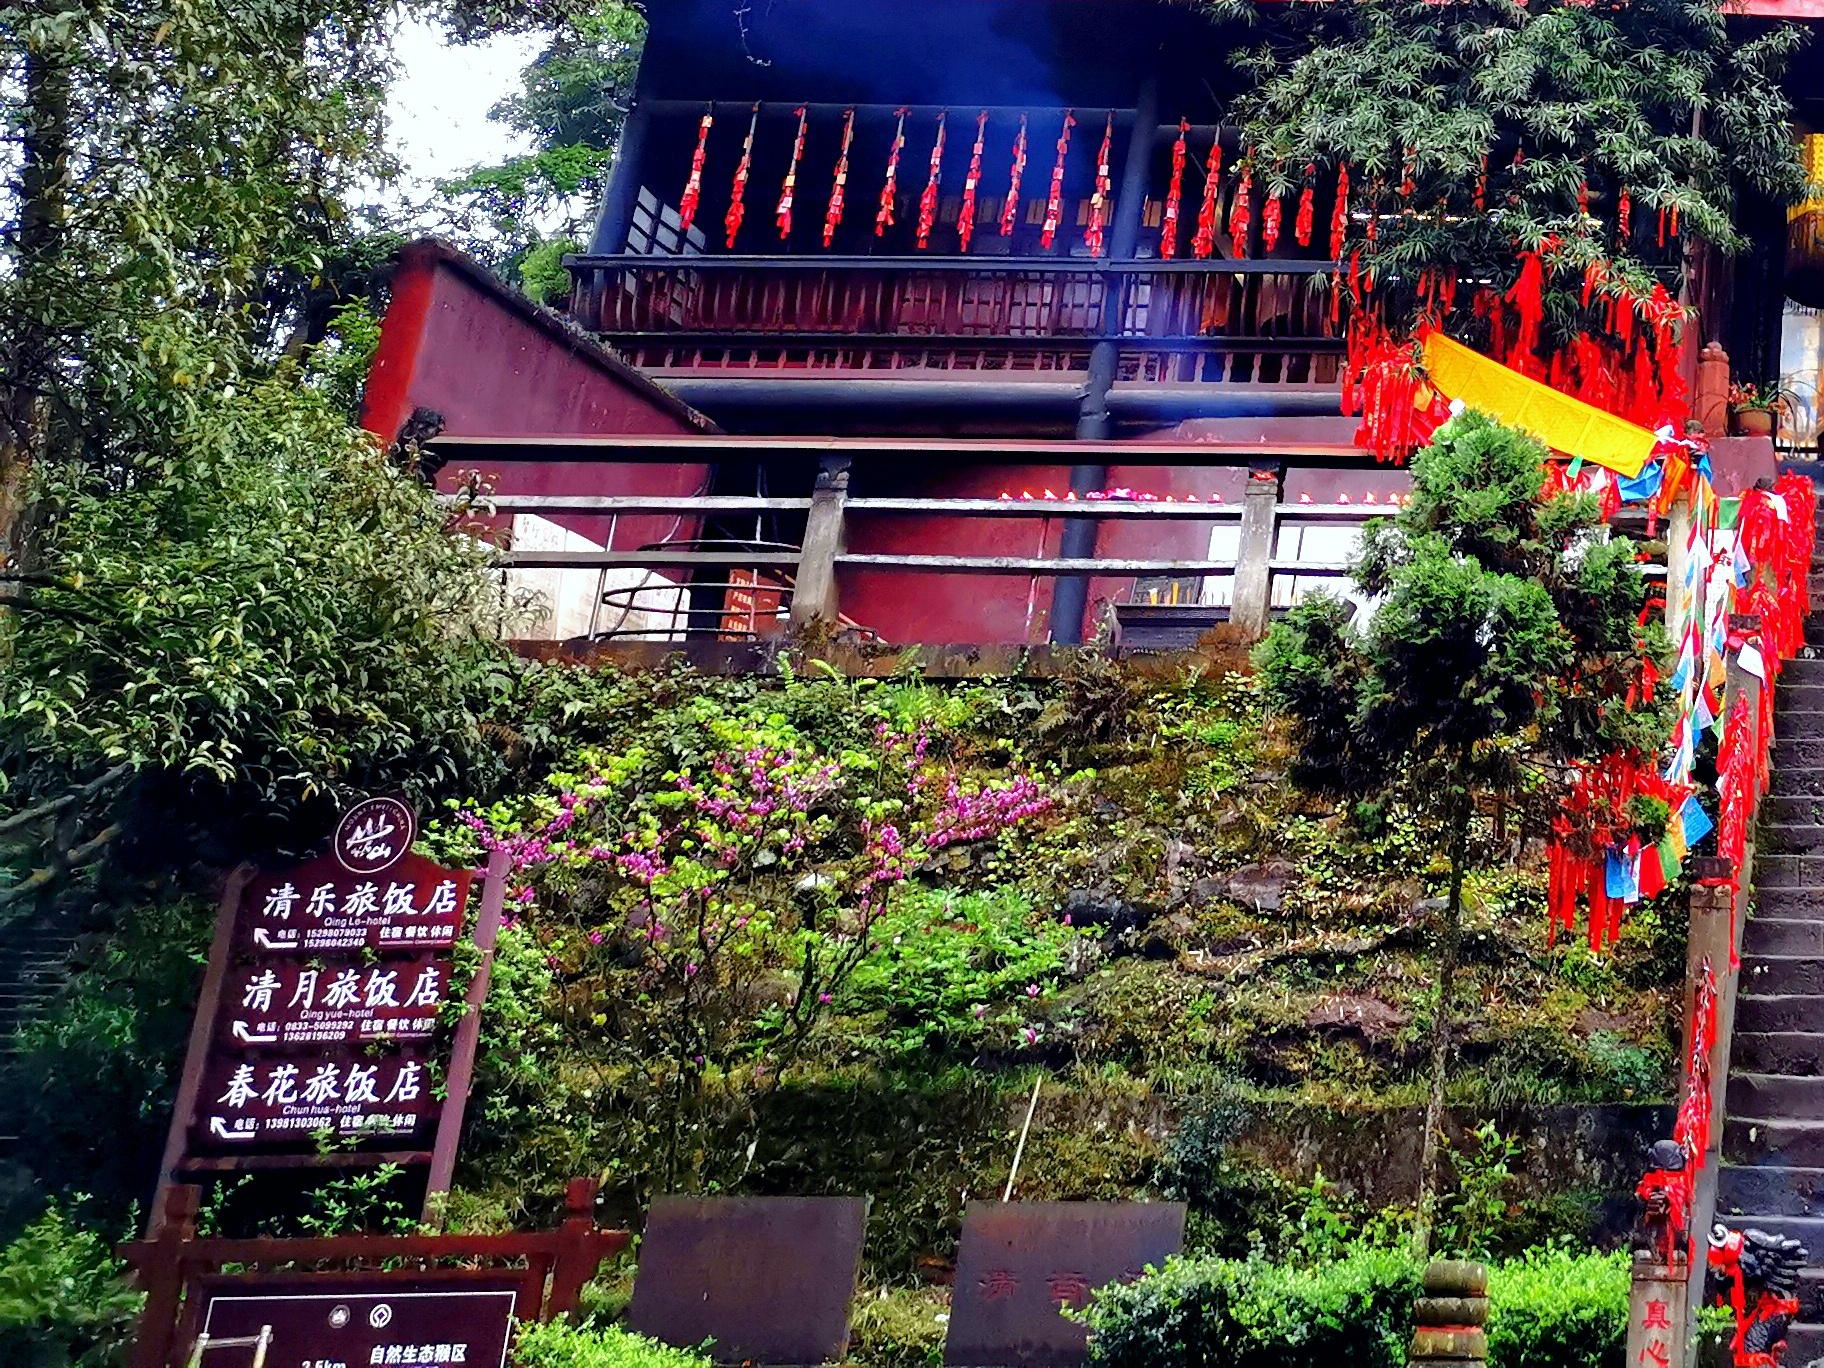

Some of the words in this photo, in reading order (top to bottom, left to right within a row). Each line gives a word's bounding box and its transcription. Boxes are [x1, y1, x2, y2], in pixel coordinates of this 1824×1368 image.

[263, 880, 457, 920] 清乐旅饭店
[242, 967, 440, 1012] 清月旅饭店
[217, 1061, 421, 1108] 春花旅饭店
[370, 1343, 467, 1364] 自然生态猴区
